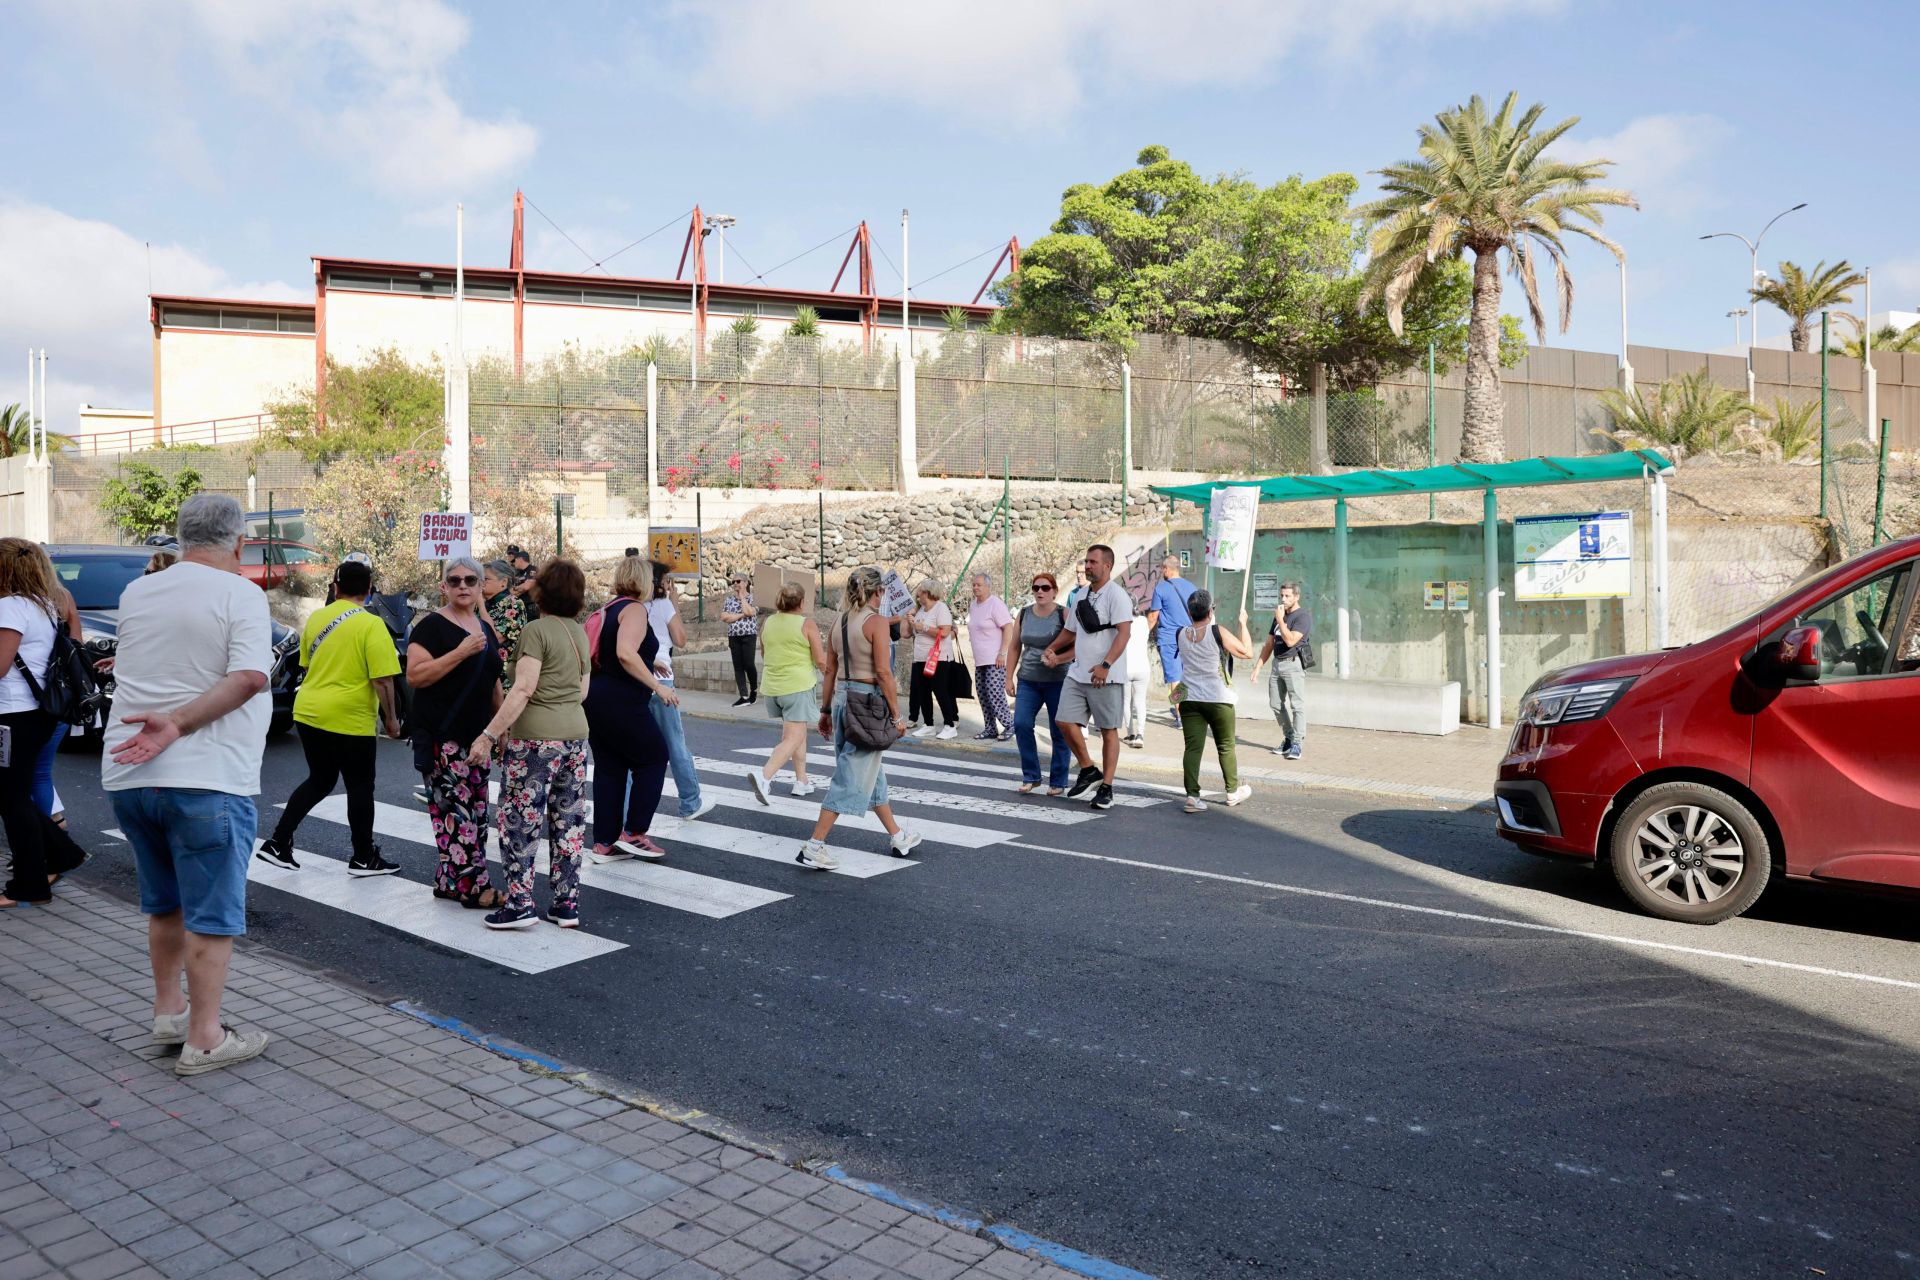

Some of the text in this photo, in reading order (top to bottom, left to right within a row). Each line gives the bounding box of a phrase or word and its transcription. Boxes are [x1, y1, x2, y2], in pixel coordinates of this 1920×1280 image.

[423, 514, 465, 527] BARRIO
[423, 528, 467, 541] SEGURO
[434, 543, 449, 556] YA
